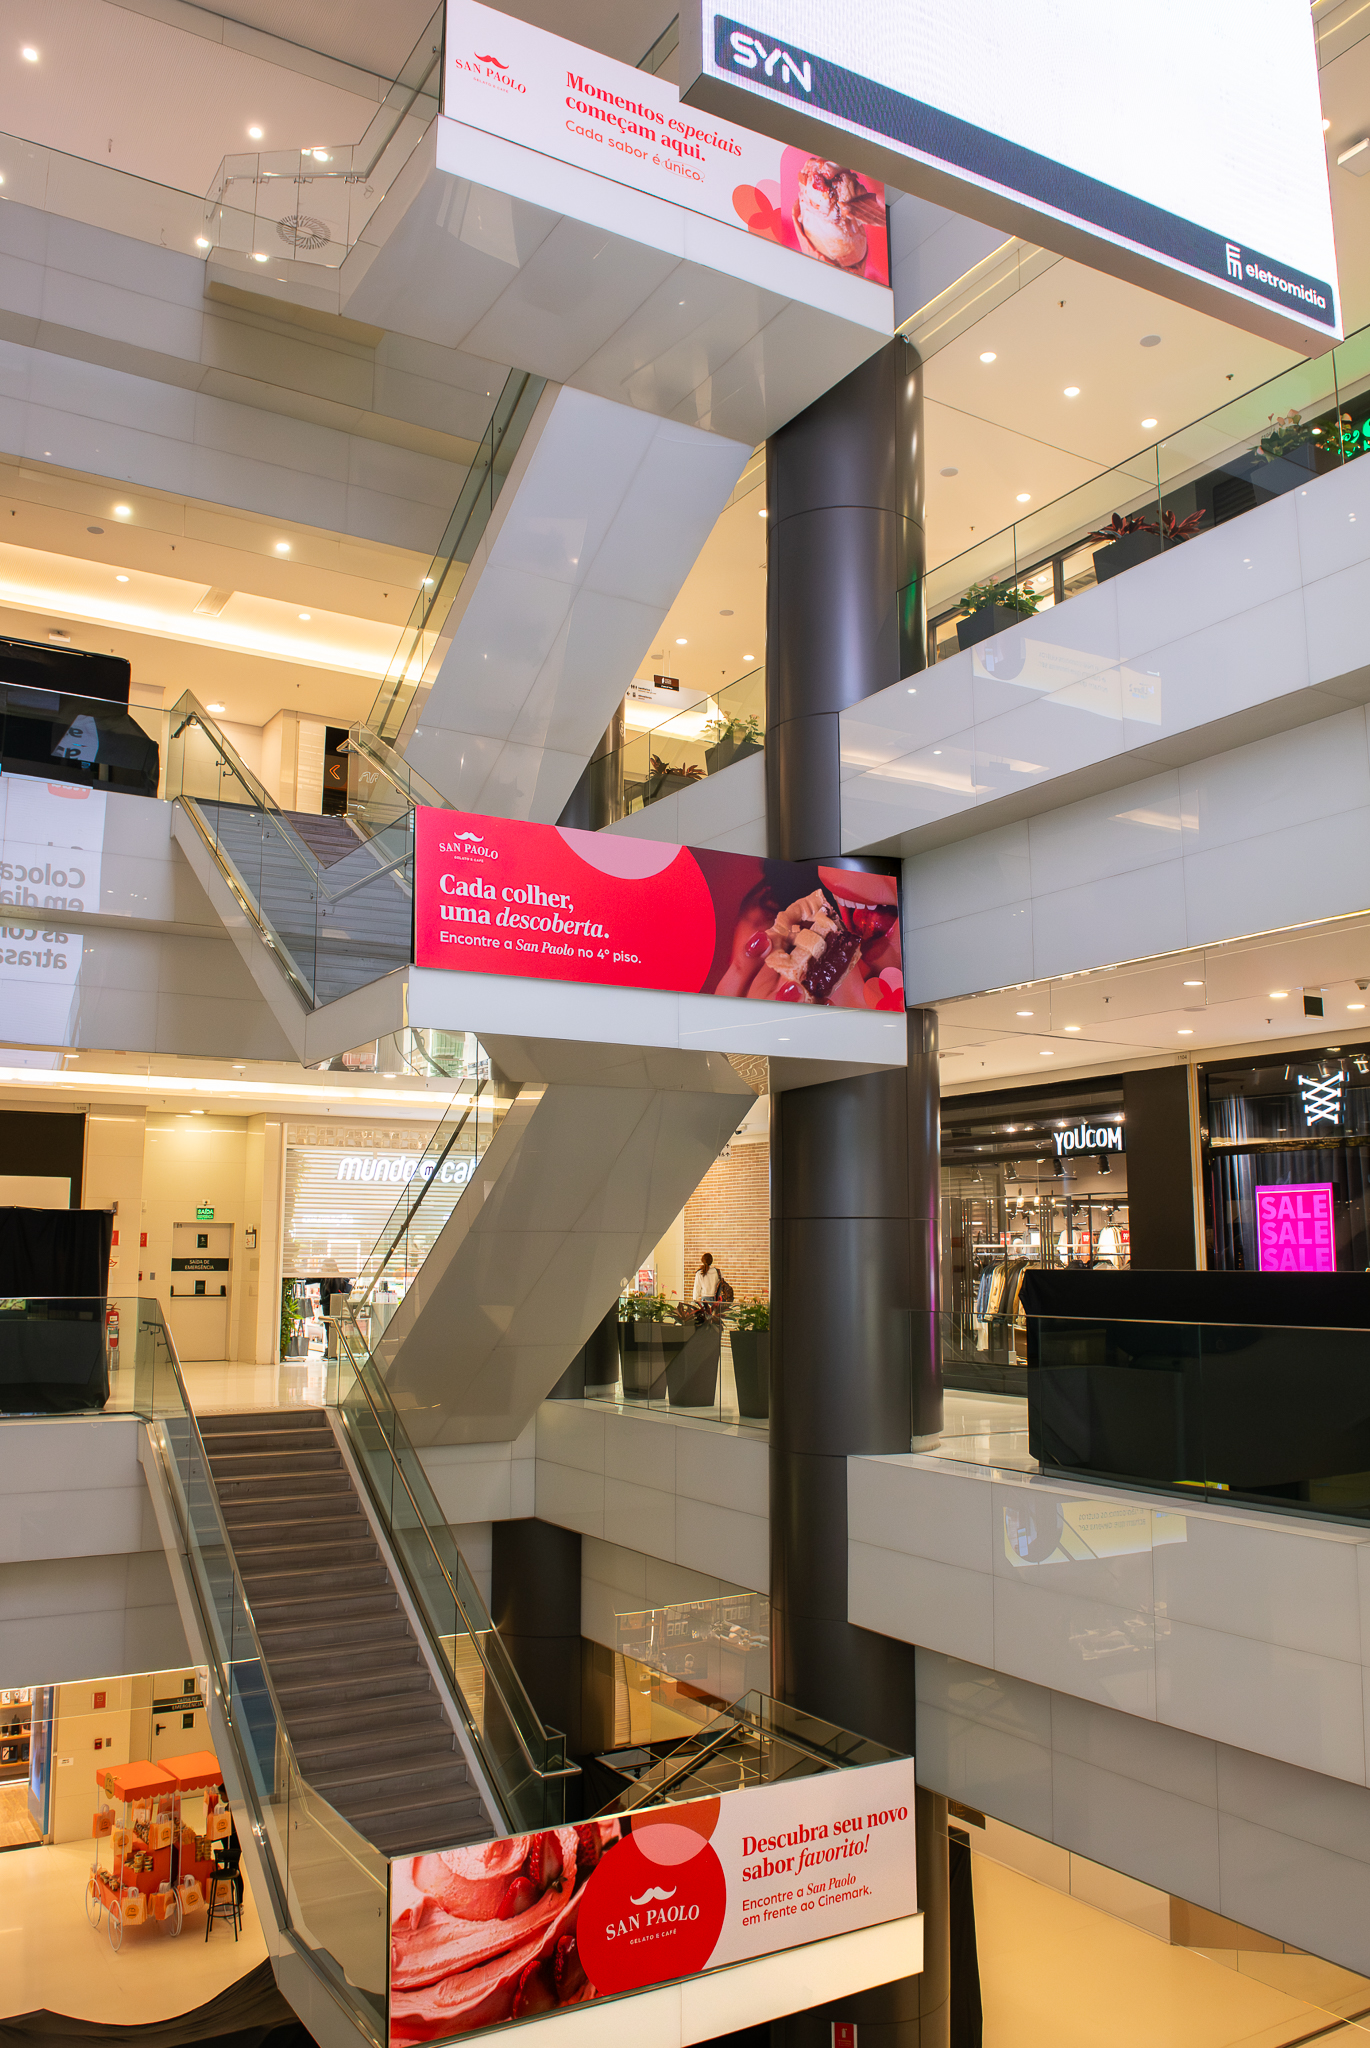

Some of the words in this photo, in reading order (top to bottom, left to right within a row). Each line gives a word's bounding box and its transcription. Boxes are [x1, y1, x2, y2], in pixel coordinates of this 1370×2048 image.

[455, 58, 481, 74] SAN
[486, 67, 527, 94] PAOLO
[729, 31, 812, 92] SYN
[565, 96, 656, 142] começam
[661, 133, 706, 162] aqui.
[566, 71, 664, 125] Momentos
[668, 117, 743, 157] especiais
[565, 120, 603, 143] Cada
[608, 138, 649, 160] sabor
[652, 153, 661, 165] é
[664, 158, 704, 183] único.
[1245, 263, 1327, 309] eletromidia
[439, 842, 461, 852] SAN
[464, 843, 499, 860] PAOLO
[439, 873, 497, 900] Cada
[501, 884, 574, 913] colher,
[439, 904, 491, 925] uma
[495, 906, 610, 939] descoberta.
[440, 931, 500, 949] Encontre
[504, 940, 512, 950] a
[515, 938, 539, 953] San
[541, 941, 574, 957] Paolo
[577, 948, 593, 958] no
[613, 950, 641, 964] piso.
[1053, 1124, 1123, 1156] YOUCOM
[337, 1155, 419, 1182] mundo
[1261, 1194, 1328, 1220] SALE
[1262, 1220, 1329, 1246] SALE
[1263, 1247, 1331, 1271] SALE
[741, 1824, 829, 1857] Descubra
[833, 1816, 863, 1836] seu
[866, 1806, 908, 1829] novo
[742, 1856, 795, 1882] sabor
[794, 1833, 870, 1876] favorito!
[742, 1889, 794, 1911] Encontre
[796, 1888, 804, 1898] a
[806, 1882, 826, 1896] San
[828, 1873, 857, 1890] Paolo
[742, 1913, 761, 1926] em
[763, 1904, 797, 1922] frente
[800, 1901, 815, 1912] ao
[818, 1885, 872, 1907] Cinemark.
[605, 1913, 640, 1941] SAN
[646, 1904, 700, 1927] PAOLO
[629, 1934, 654, 1945] GELATO
[661, 1928, 677, 1937] CAFÉ
